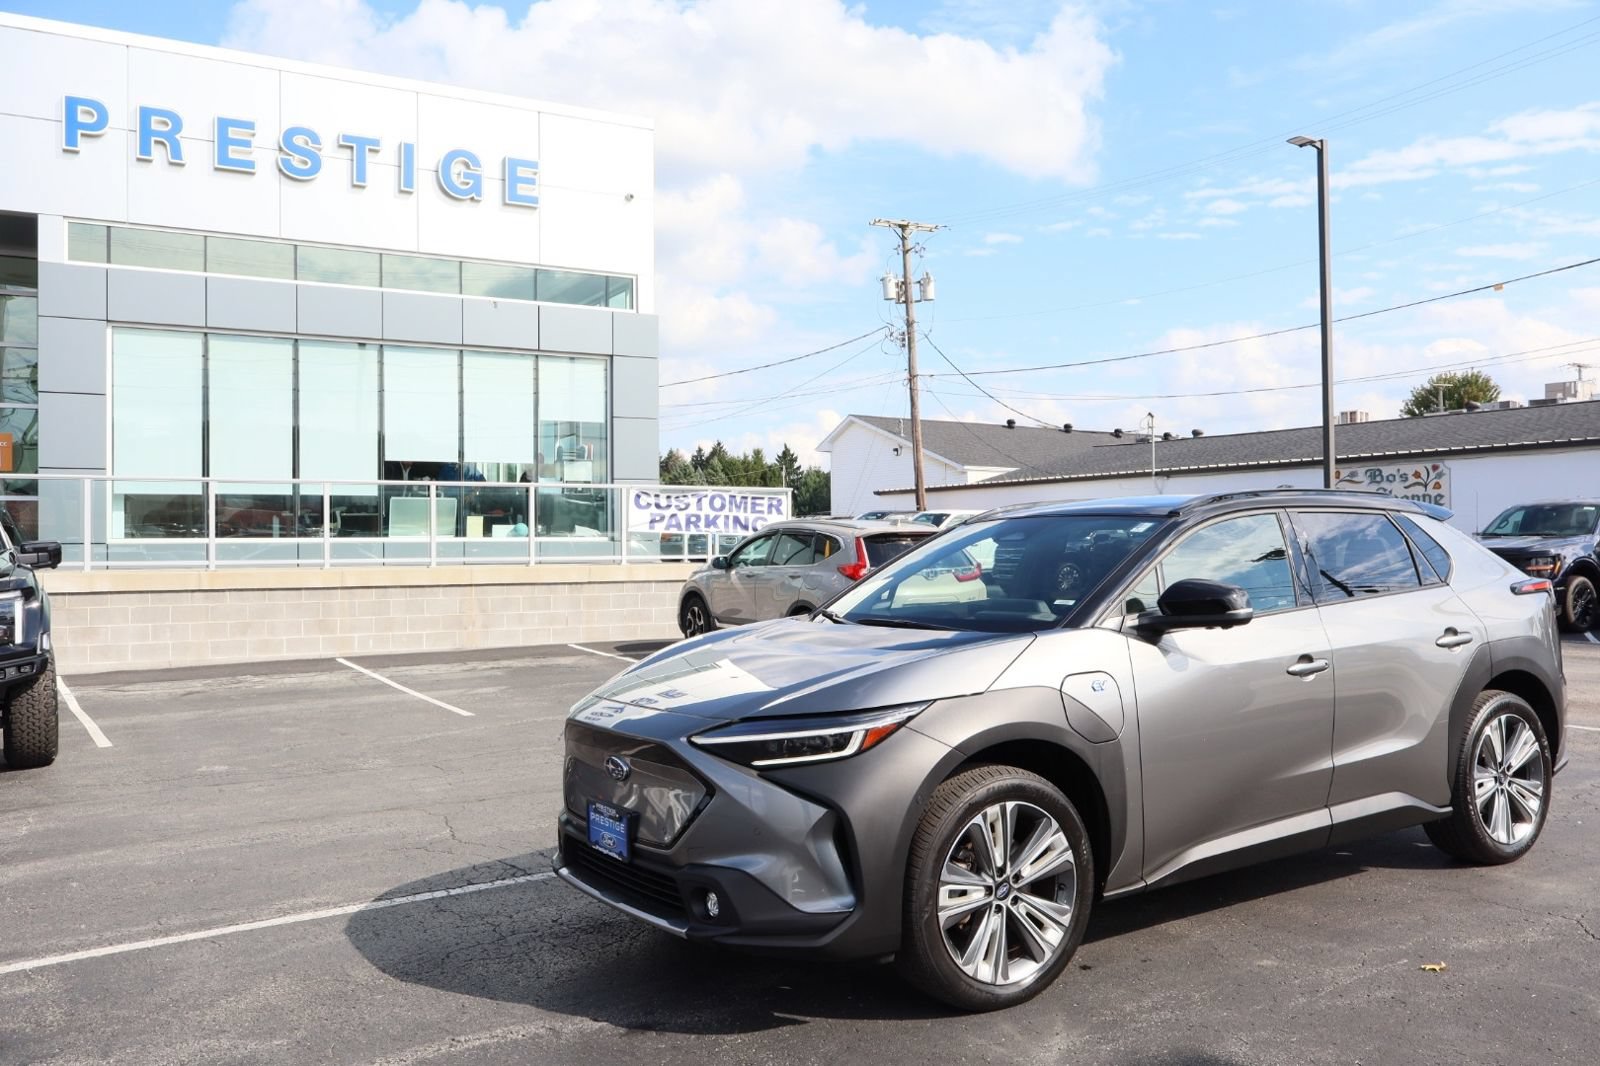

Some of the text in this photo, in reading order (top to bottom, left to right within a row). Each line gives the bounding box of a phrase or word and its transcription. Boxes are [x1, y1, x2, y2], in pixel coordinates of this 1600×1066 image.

[62, 94, 541, 209] PRESTIGE
[1365, 467, 1409, 486] Bo's
[634, 491, 784, 516] CUSTOMER
[1375, 487, 1446, 506] ppe
[649, 512, 769, 533] PARKING
[590, 812, 625, 834] PRESTIGE
